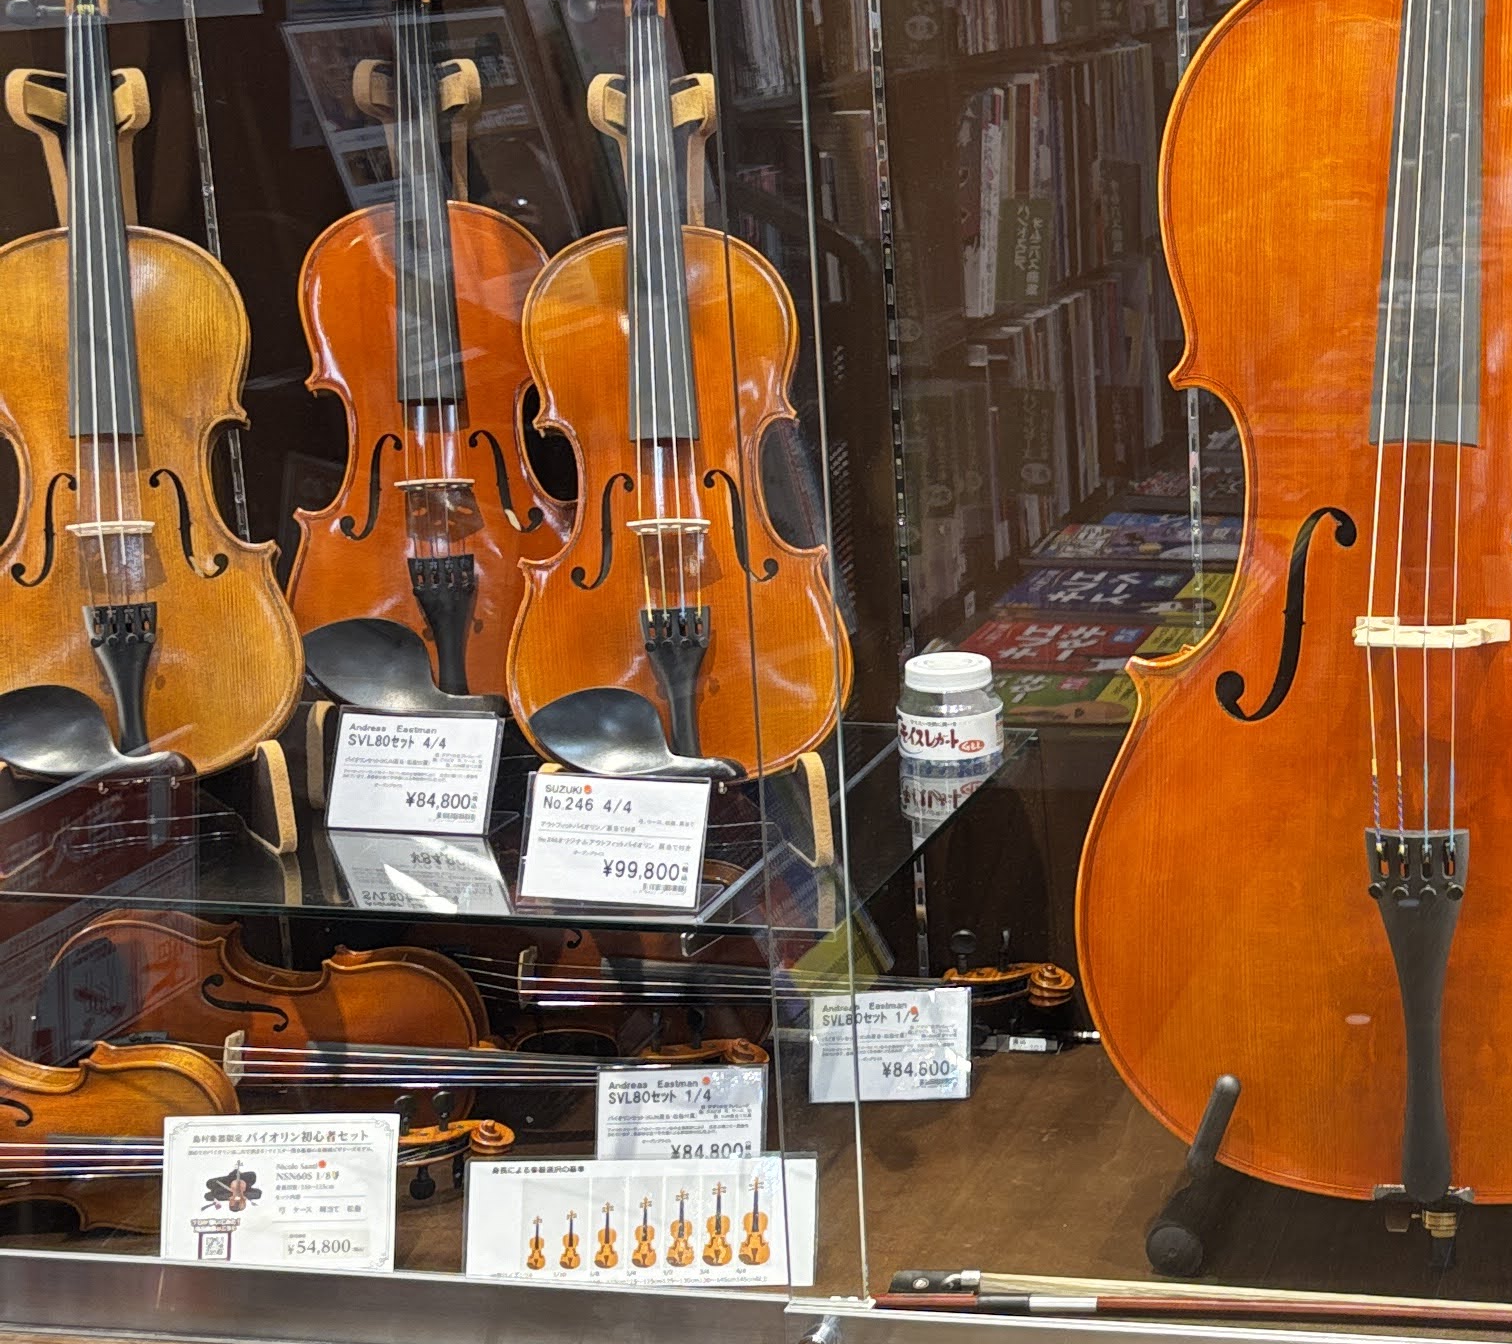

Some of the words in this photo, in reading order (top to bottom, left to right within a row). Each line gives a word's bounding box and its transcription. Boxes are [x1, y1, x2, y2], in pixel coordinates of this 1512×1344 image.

[396, 725, 437, 734] Eastman
[348, 734, 415, 749] SVL80セット
[423, 737, 446, 749] 4/4
[545, 784, 582, 794] SUZUKI
[405, 791, 471, 810] ¥84,800
[543, 796, 594, 811] No.246
[603, 799, 632, 813] 4/4
[602, 858, 680, 881] ¥99,800
[657, 1079, 698, 1088] Eastman
[608, 1090, 676, 1104] SVL80セット
[685, 1088, 711, 1103] 1/4
[245, 1130, 368, 1144] バイオリン初心者セット
[671, 1142, 743, 1159] ¥84,800
[288, 1239, 351, 1255] ¥54,800
